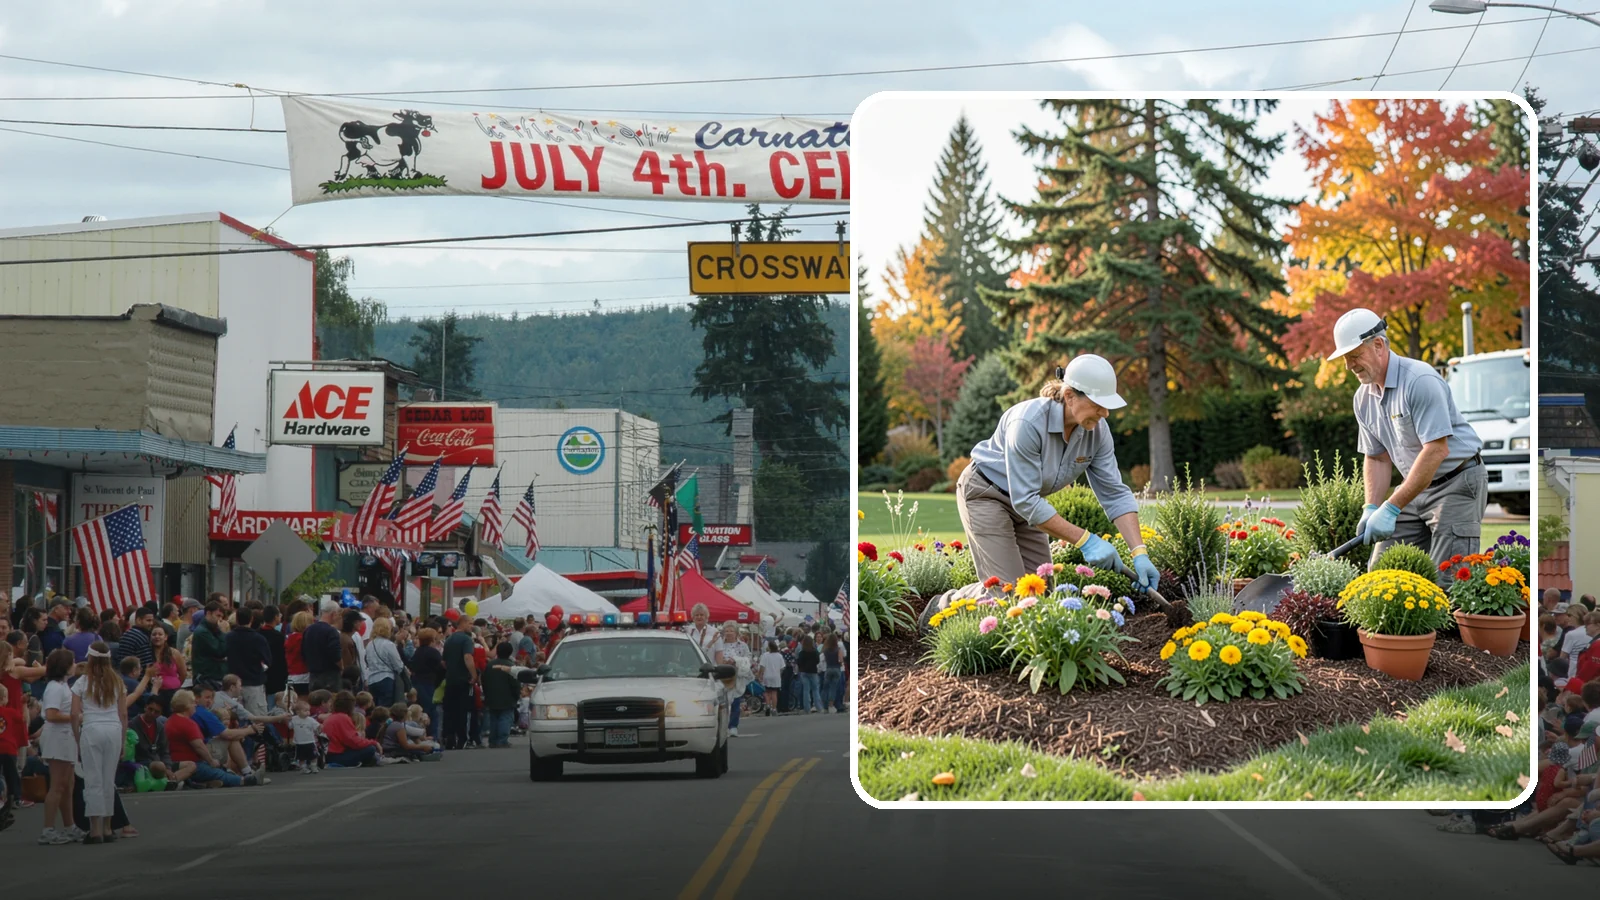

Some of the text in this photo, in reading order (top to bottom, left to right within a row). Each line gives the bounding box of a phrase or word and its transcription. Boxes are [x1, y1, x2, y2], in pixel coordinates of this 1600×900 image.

[695, 121, 850, 150] Carnat
[481, 141, 605, 192] JULY
[632, 150, 746, 197] 4th.
[697, 254, 850, 280] CROSSWA
[282, 379, 373, 420] ACE
[406, 409, 452, 421] CEDAR
[283, 421, 370, 436] Hardware
[416, 428, 477, 446] Coca-Cola
[354, 467, 385, 479] Simpl
[95, 485, 124, 494] Vincent
[126, 486, 135, 494] de
[137, 486, 155, 495] Paul
[688, 526, 741, 535] CRNATION
[699, 535, 730, 543] GLASS
